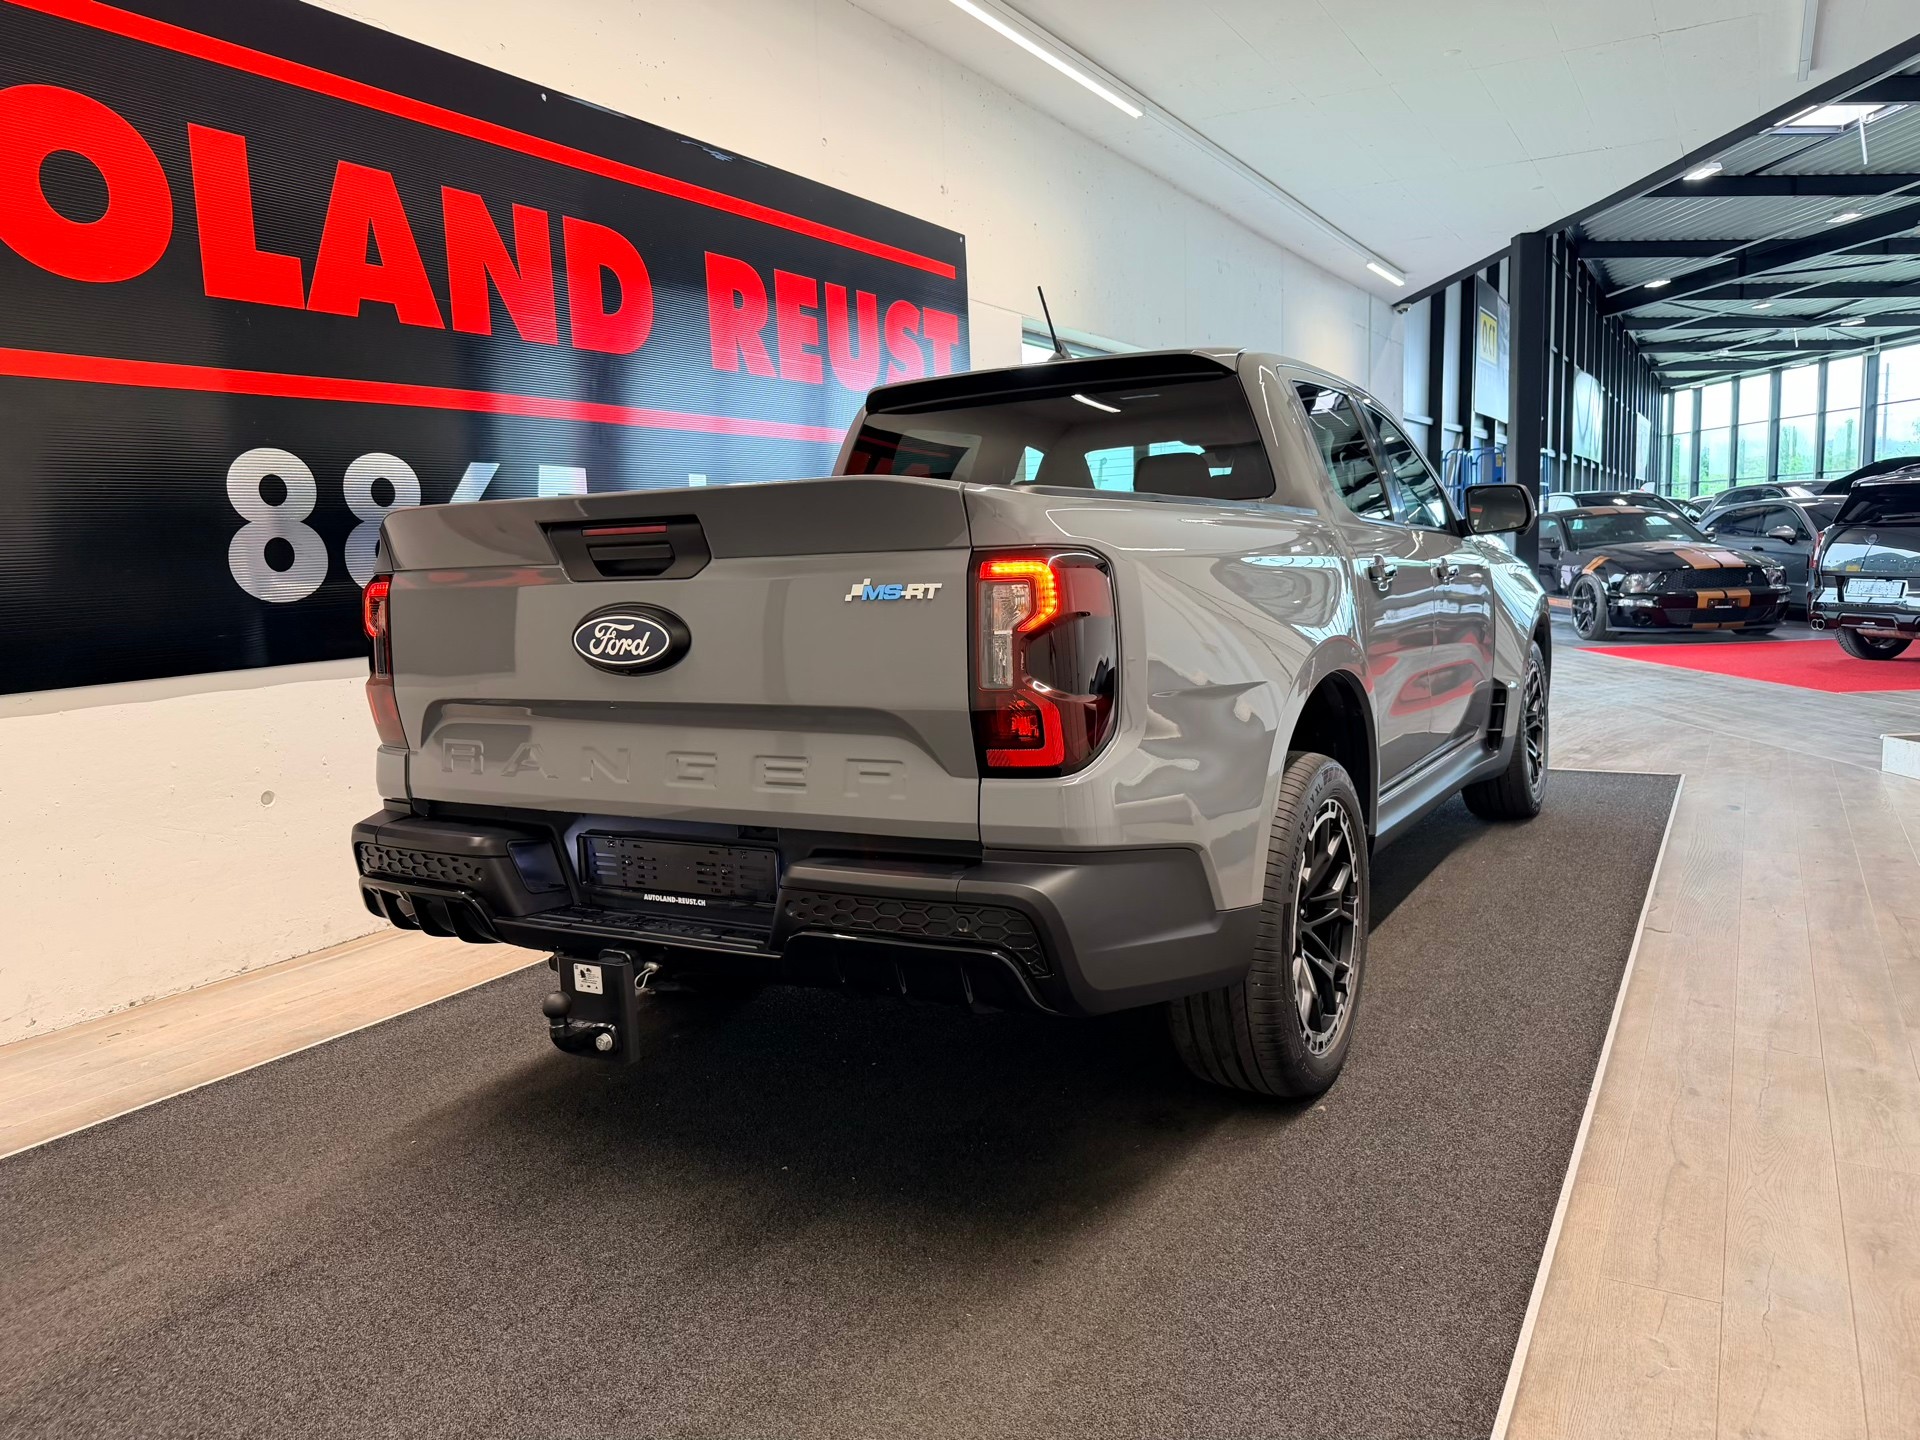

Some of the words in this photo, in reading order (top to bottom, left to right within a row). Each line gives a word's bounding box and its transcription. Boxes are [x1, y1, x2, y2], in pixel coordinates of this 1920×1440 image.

[0, 83, 654, 354] OLAND
[704, 251, 960, 392] REUST
[860, 583, 943, 601] MS-RT
[589, 622, 651, 656] Ford
[441, 737, 908, 799] RANGER
[643, 893, 706, 907] AUTOLAND-REUST.CH
